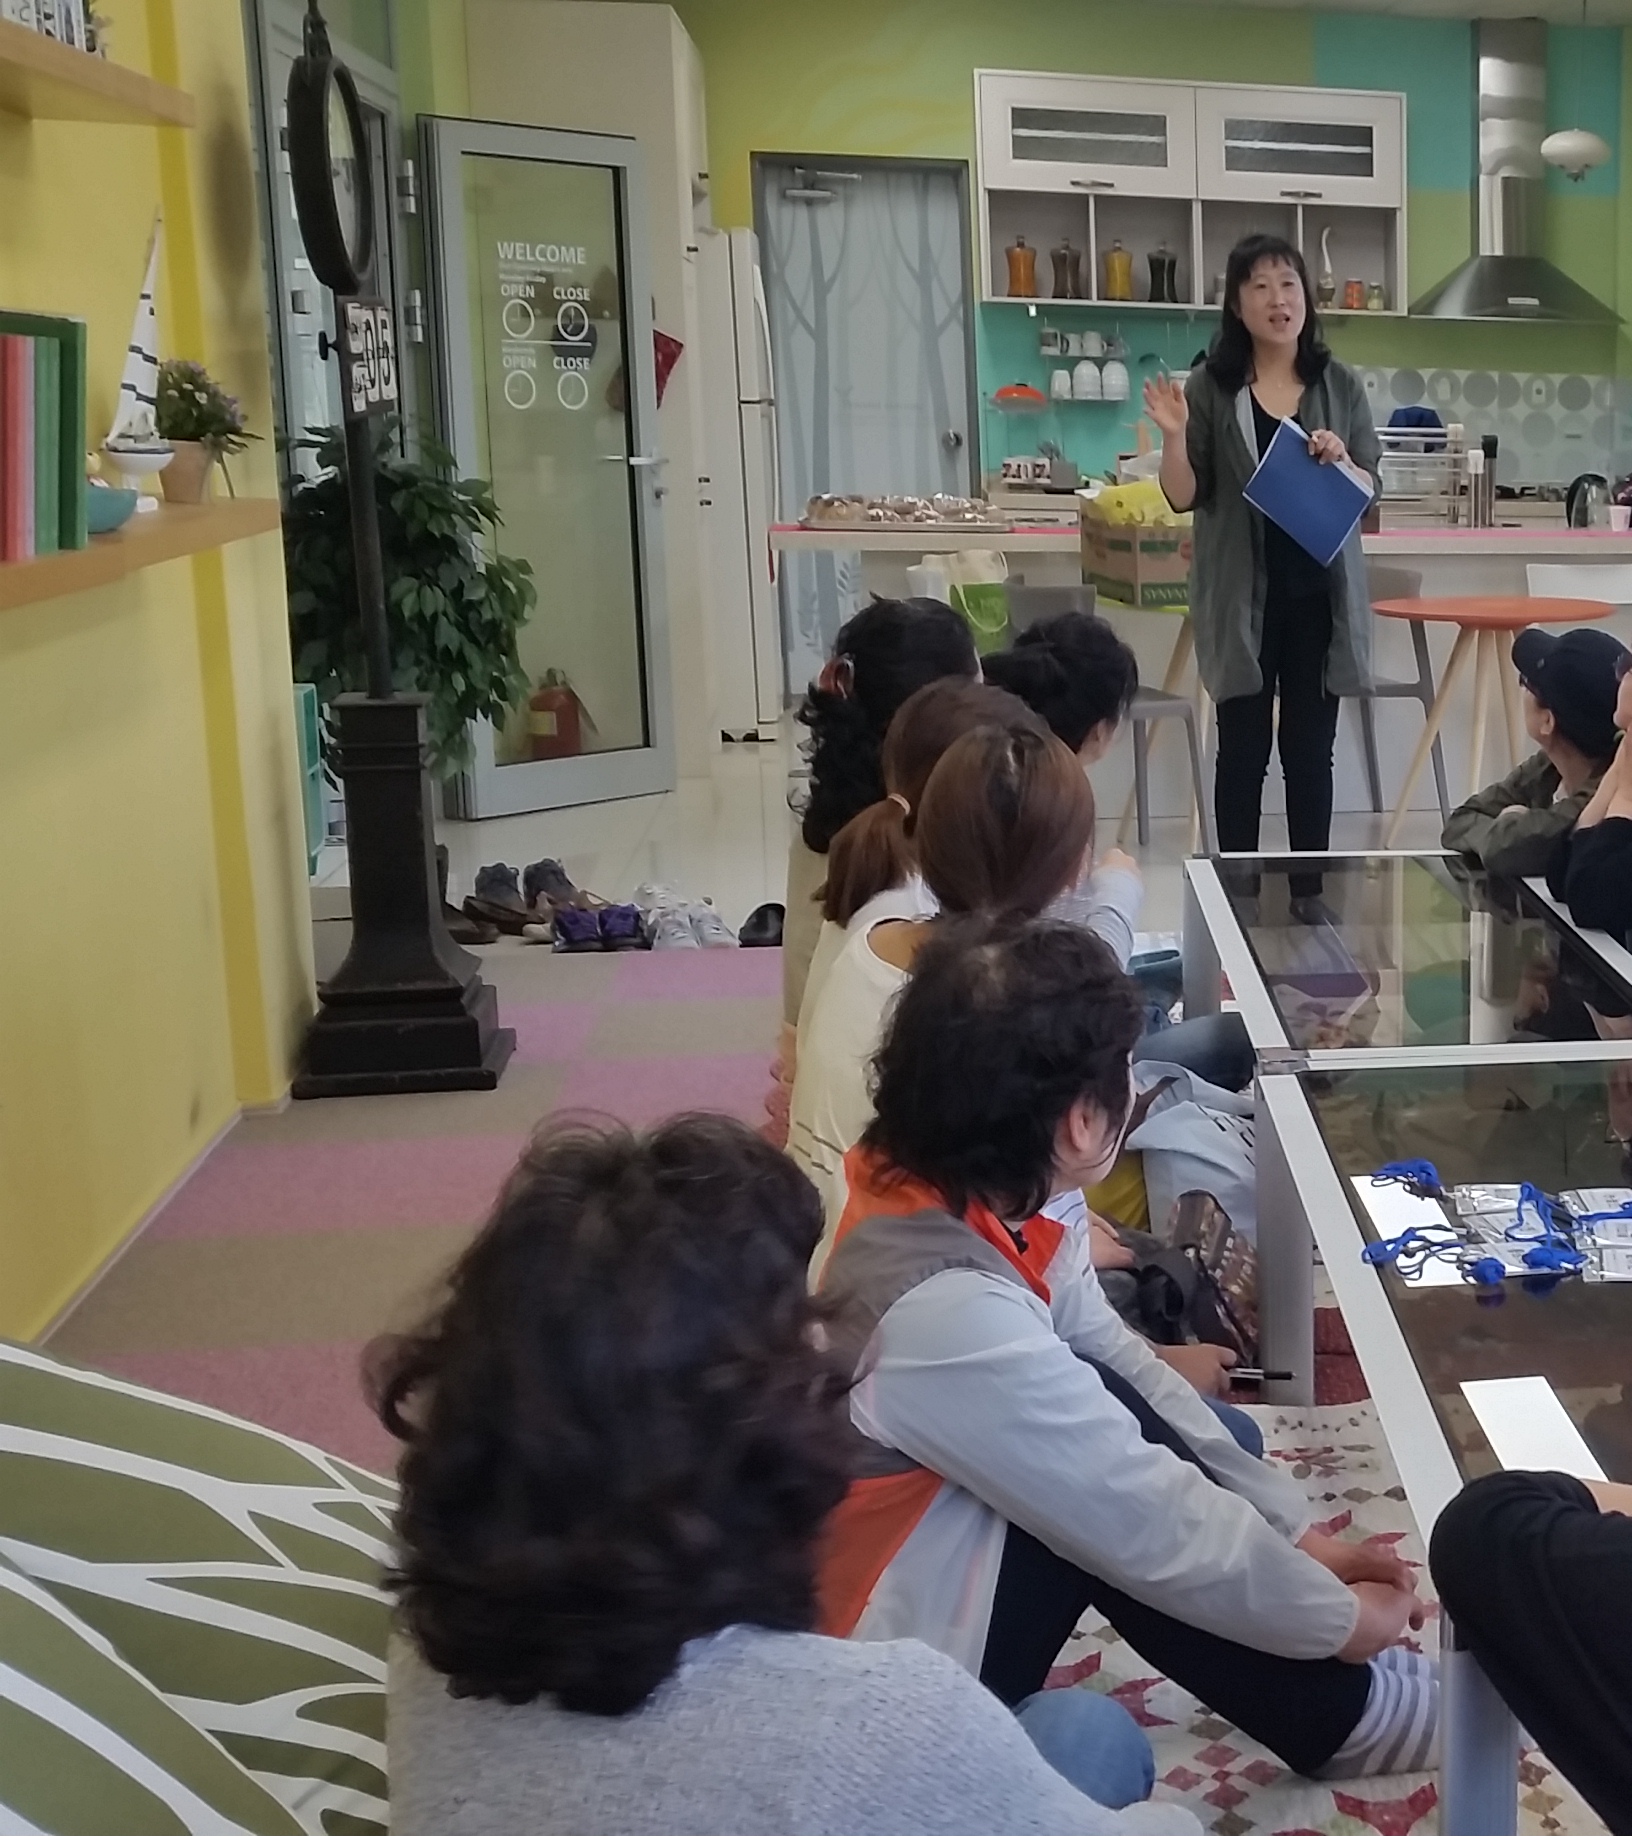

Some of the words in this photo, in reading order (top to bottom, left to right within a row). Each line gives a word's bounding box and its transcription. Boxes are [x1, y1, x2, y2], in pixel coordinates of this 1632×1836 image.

[497, 241, 586, 264] WELCOME
[501, 284, 535, 298] OPEN
[553, 286, 590, 301] CLOSE
[502, 355, 537, 369] OPEN
[553, 356, 590, 370] CLOSE
